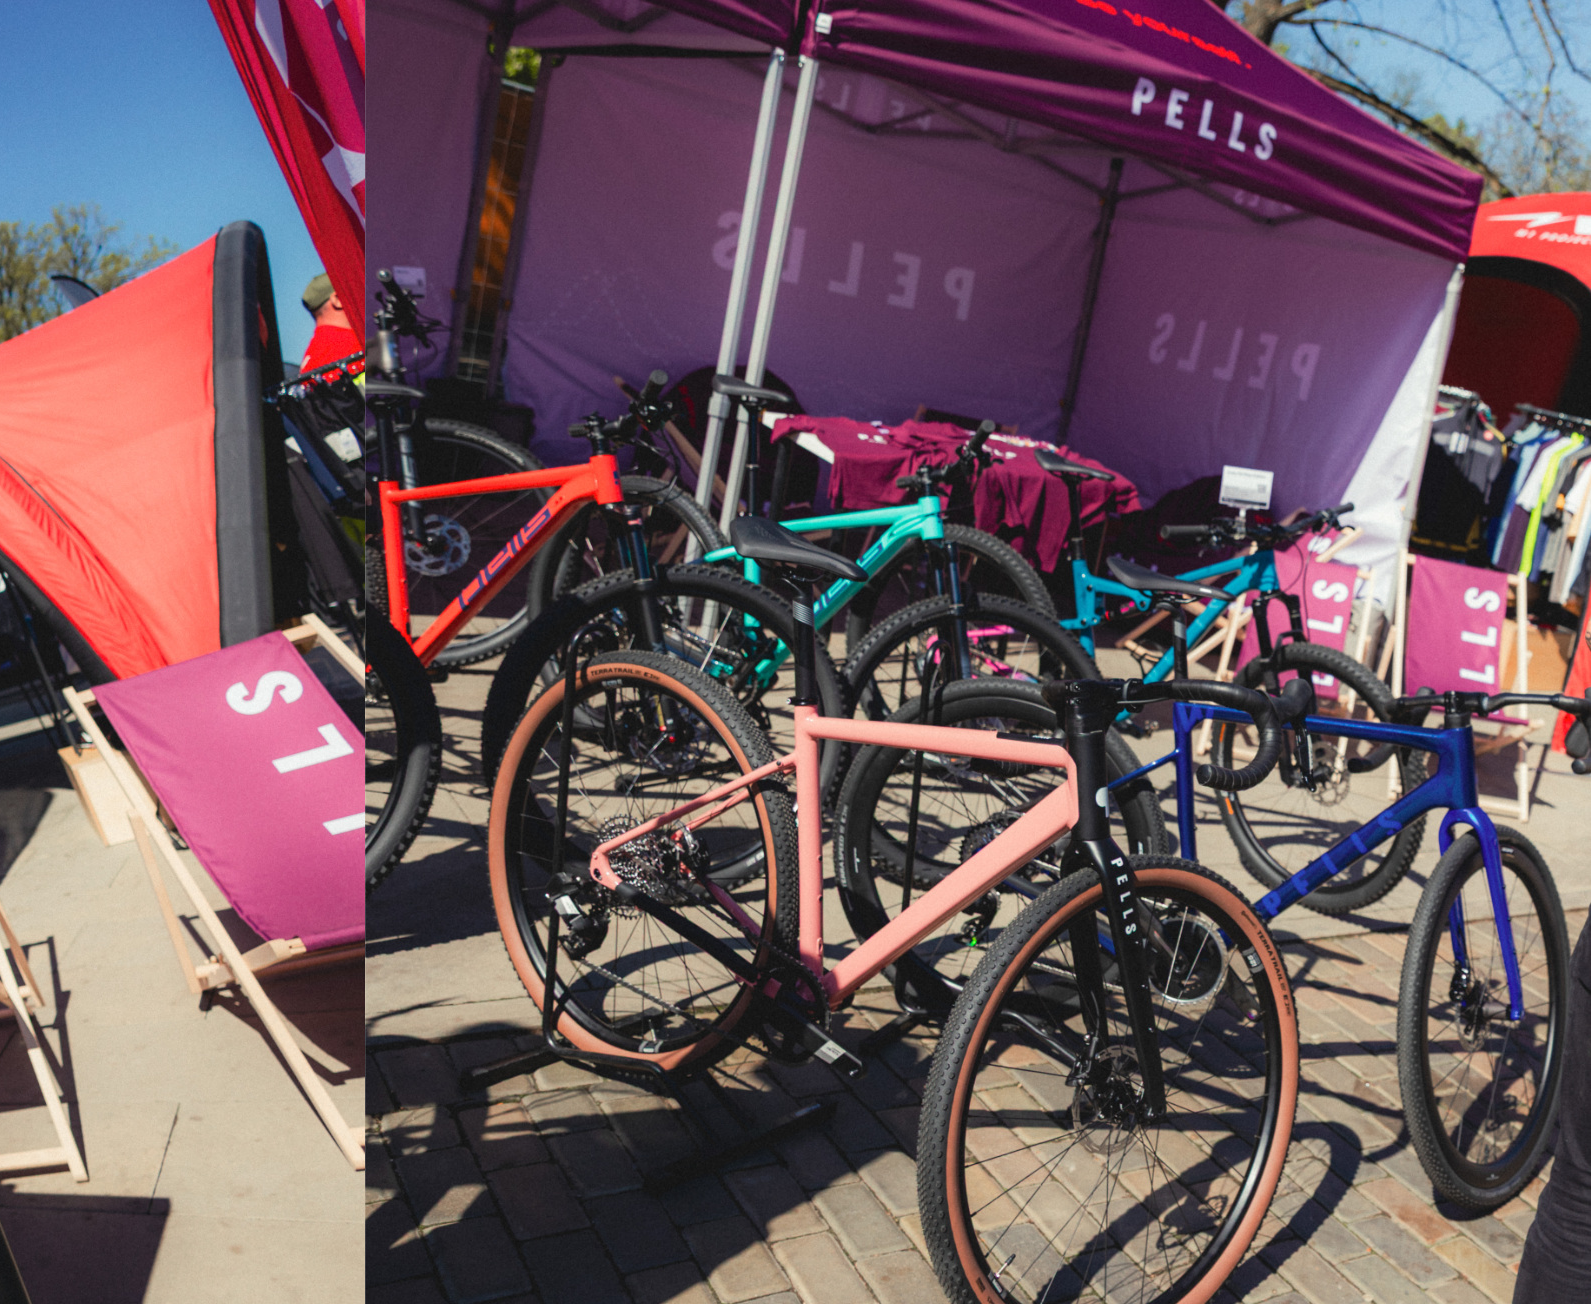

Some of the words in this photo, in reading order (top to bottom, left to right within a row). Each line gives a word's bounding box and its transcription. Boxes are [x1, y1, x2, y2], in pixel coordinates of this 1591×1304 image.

[1131, 77, 1277, 160] PELLS
[590, 667, 613, 677] TERRA
[613, 667, 634, 675] TRAIL
[1459, 587, 1501, 685] LLS
[1110, 856, 1138, 936] PELLS
[1256, 930, 1274, 957] TERRA
[1270, 957, 1284, 983] TRAIL
